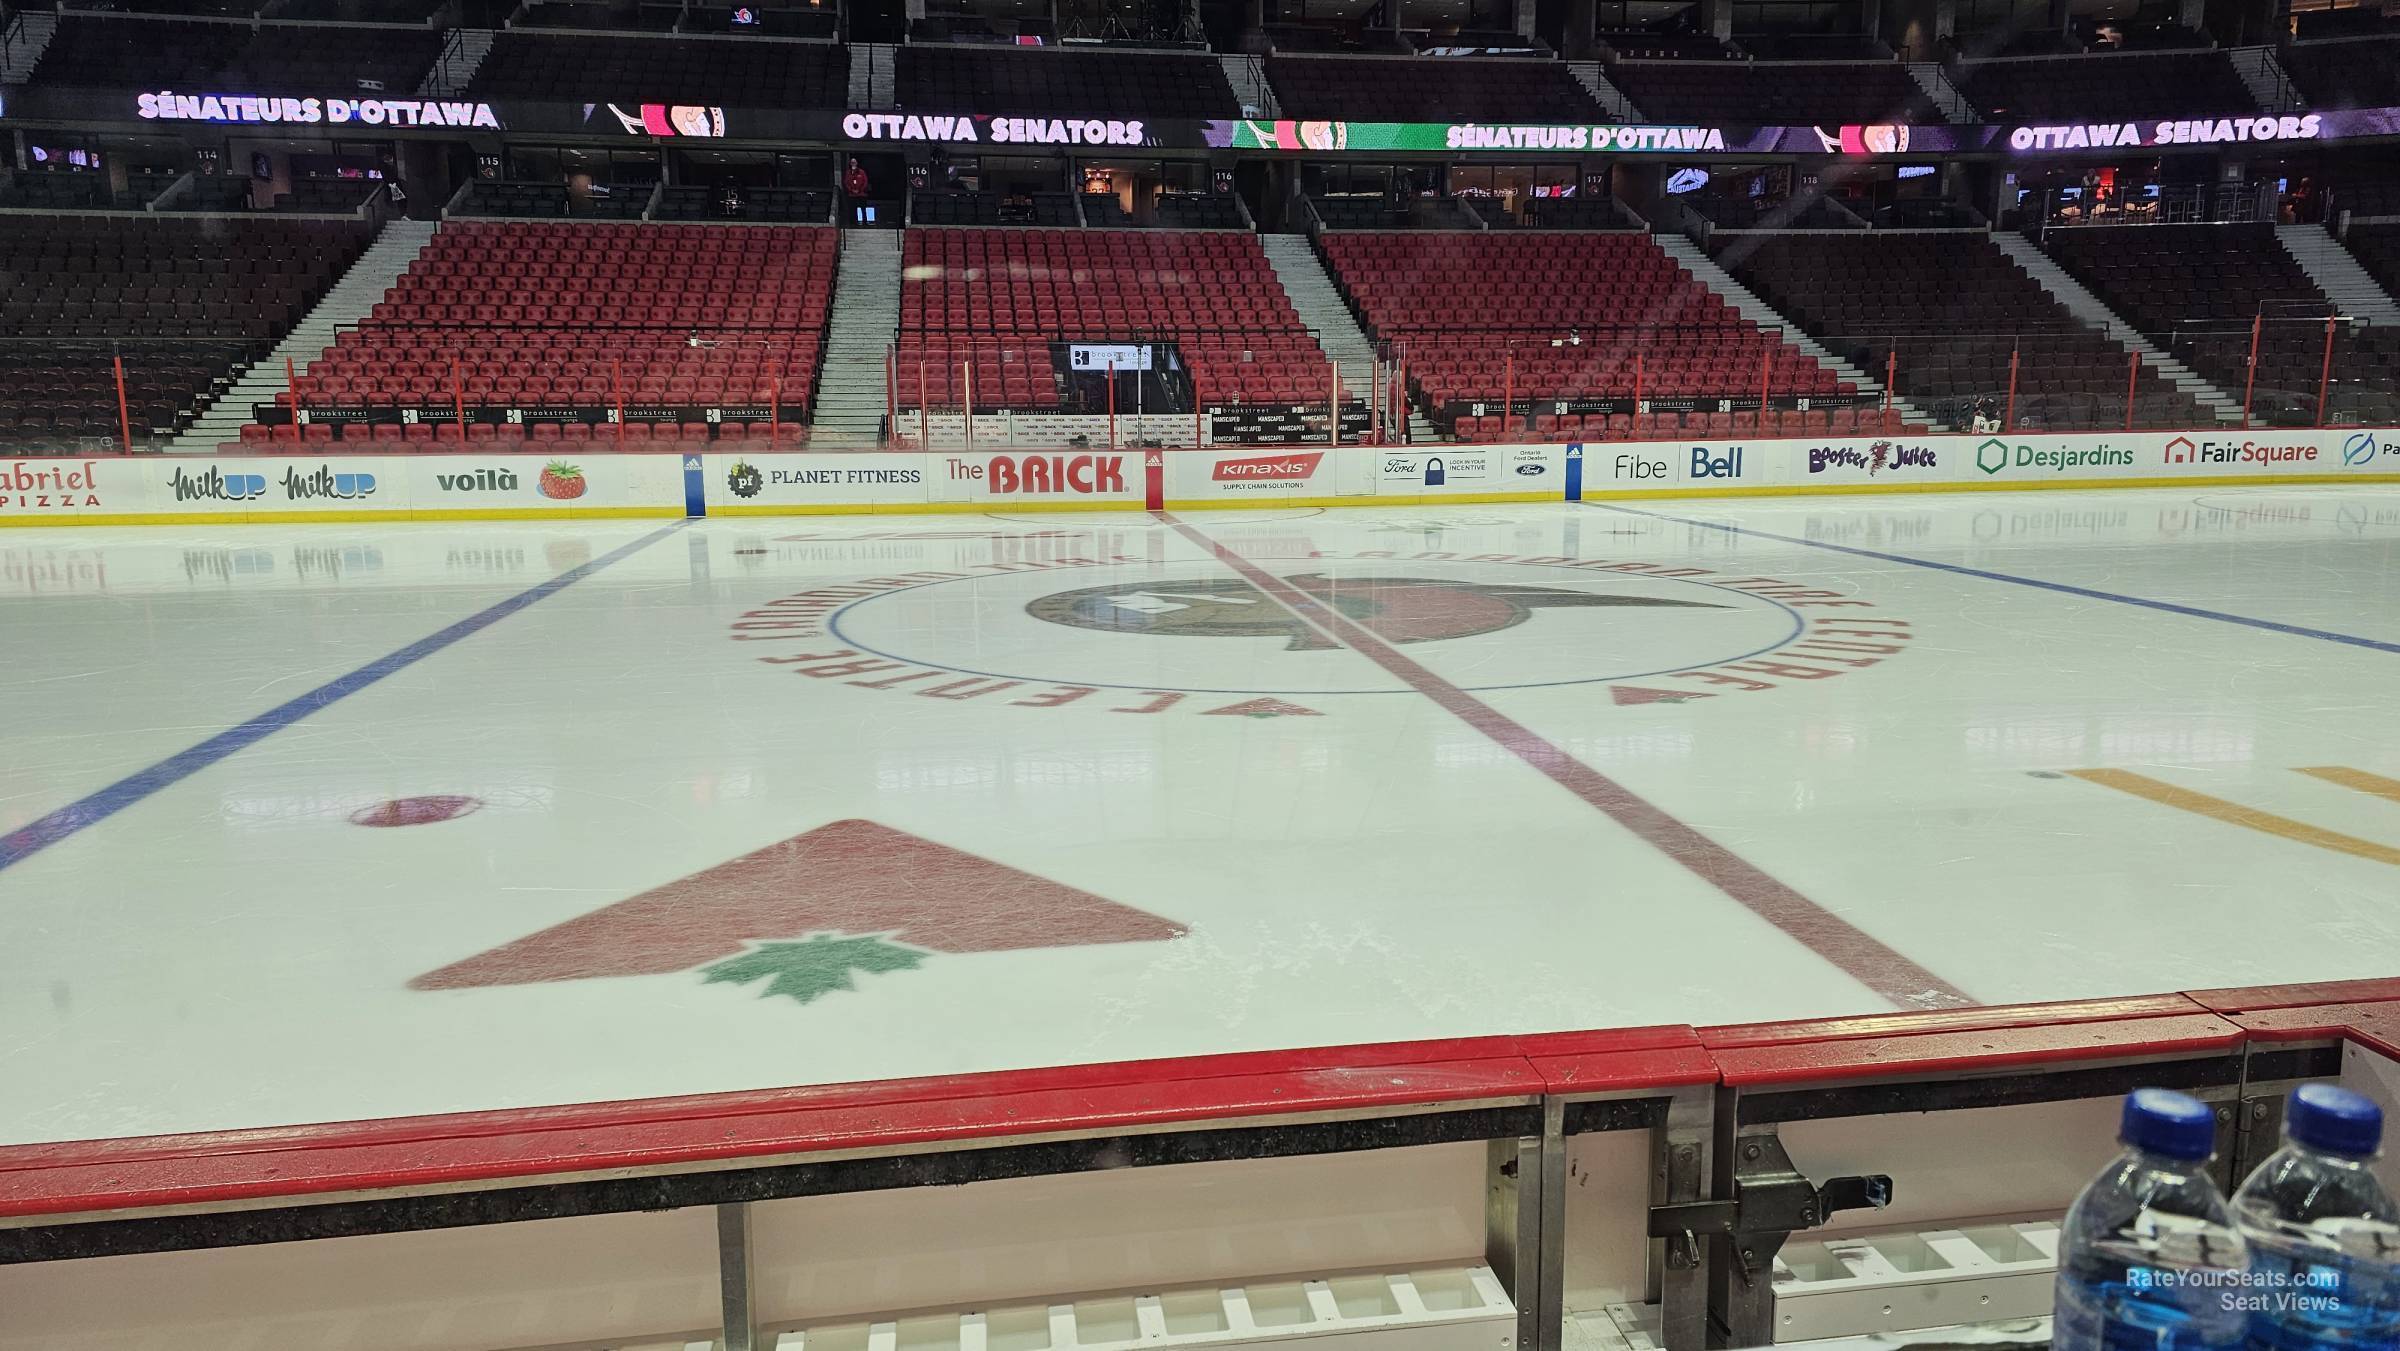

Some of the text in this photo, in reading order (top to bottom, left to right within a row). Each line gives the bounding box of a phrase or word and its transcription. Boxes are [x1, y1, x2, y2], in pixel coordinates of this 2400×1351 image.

[137, 91, 500, 129] SÉNATEURS D'OTTAWA
[842, 113, 1144, 145] OTTAWA SENATORS
[1446, 123, 1725, 151] SÉNATEURS D'OTTAWA
[2010, 115, 2322, 149] OTTAWA SENATORS
[197, 150, 217, 160] 114
[479, 156, 499, 166] 115
[909, 166, 927, 175] 116
[1215, 172, 1233, 180] 116
[1586, 175, 1602, 183] 117
[1384, 458, 1417, 473] Ford
[1691, 446, 1743, 478] Bell
[1809, 443, 1937, 473] Booster Juice
[2016, 444, 2134, 471] Desjardins
[2202, 441, 2318, 467] FairSquare
[771, 469, 921, 484] PLANET FITNESS
[945, 458, 984, 480] The
[1615, 454, 1667, 479] Fibe
[436, 468, 519, 492] voilà
